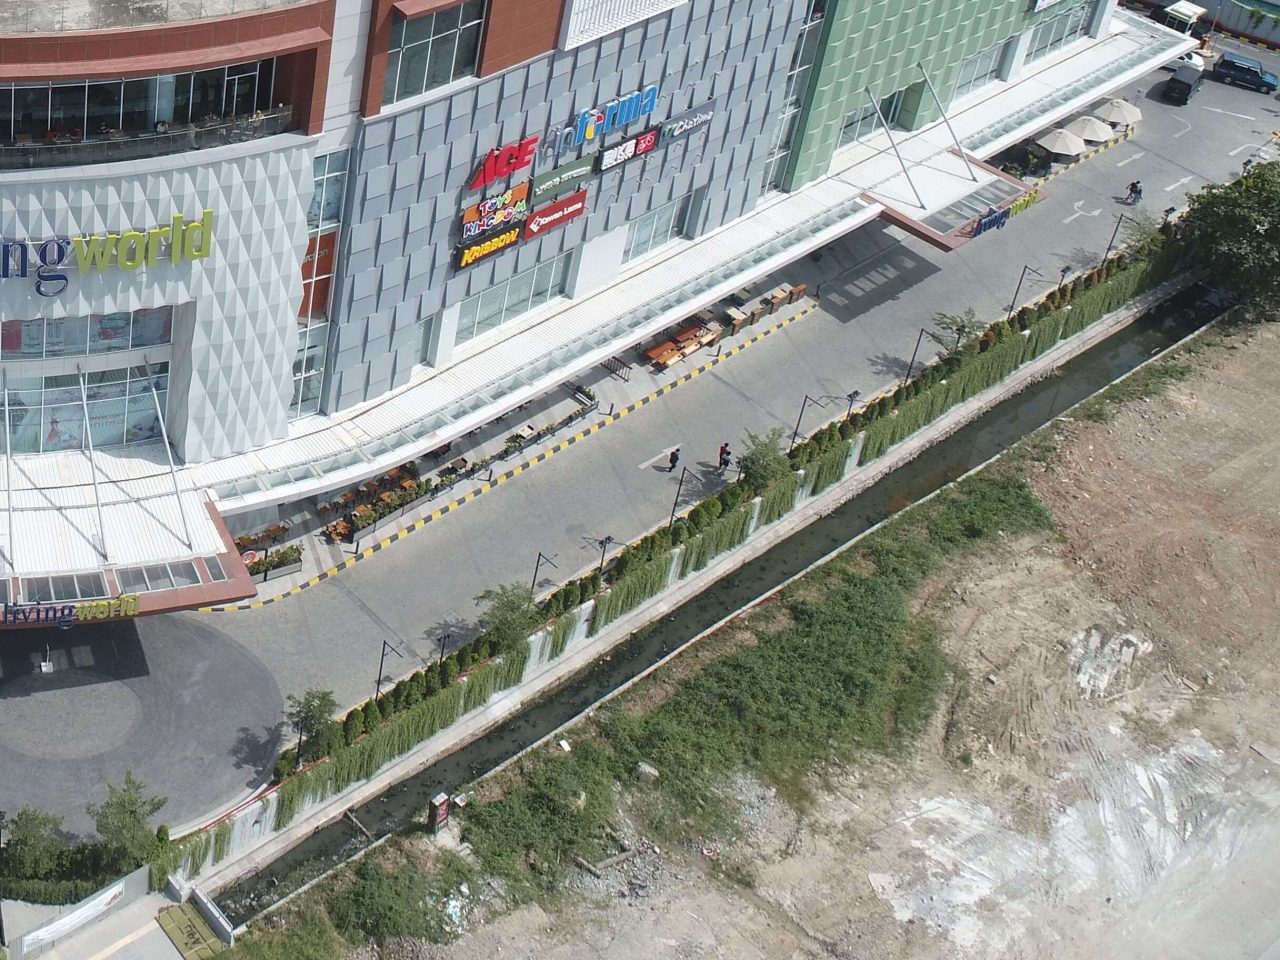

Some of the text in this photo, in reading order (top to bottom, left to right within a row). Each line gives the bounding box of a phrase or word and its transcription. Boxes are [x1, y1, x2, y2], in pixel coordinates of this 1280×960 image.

[674, 111, 714, 136] Chatime
[468, 135, 540, 191] ACE
[462, 200, 527, 239] KINGDOM
[479, 189, 513, 216] TOYS
[460, 228, 520, 268] KRISBOW
